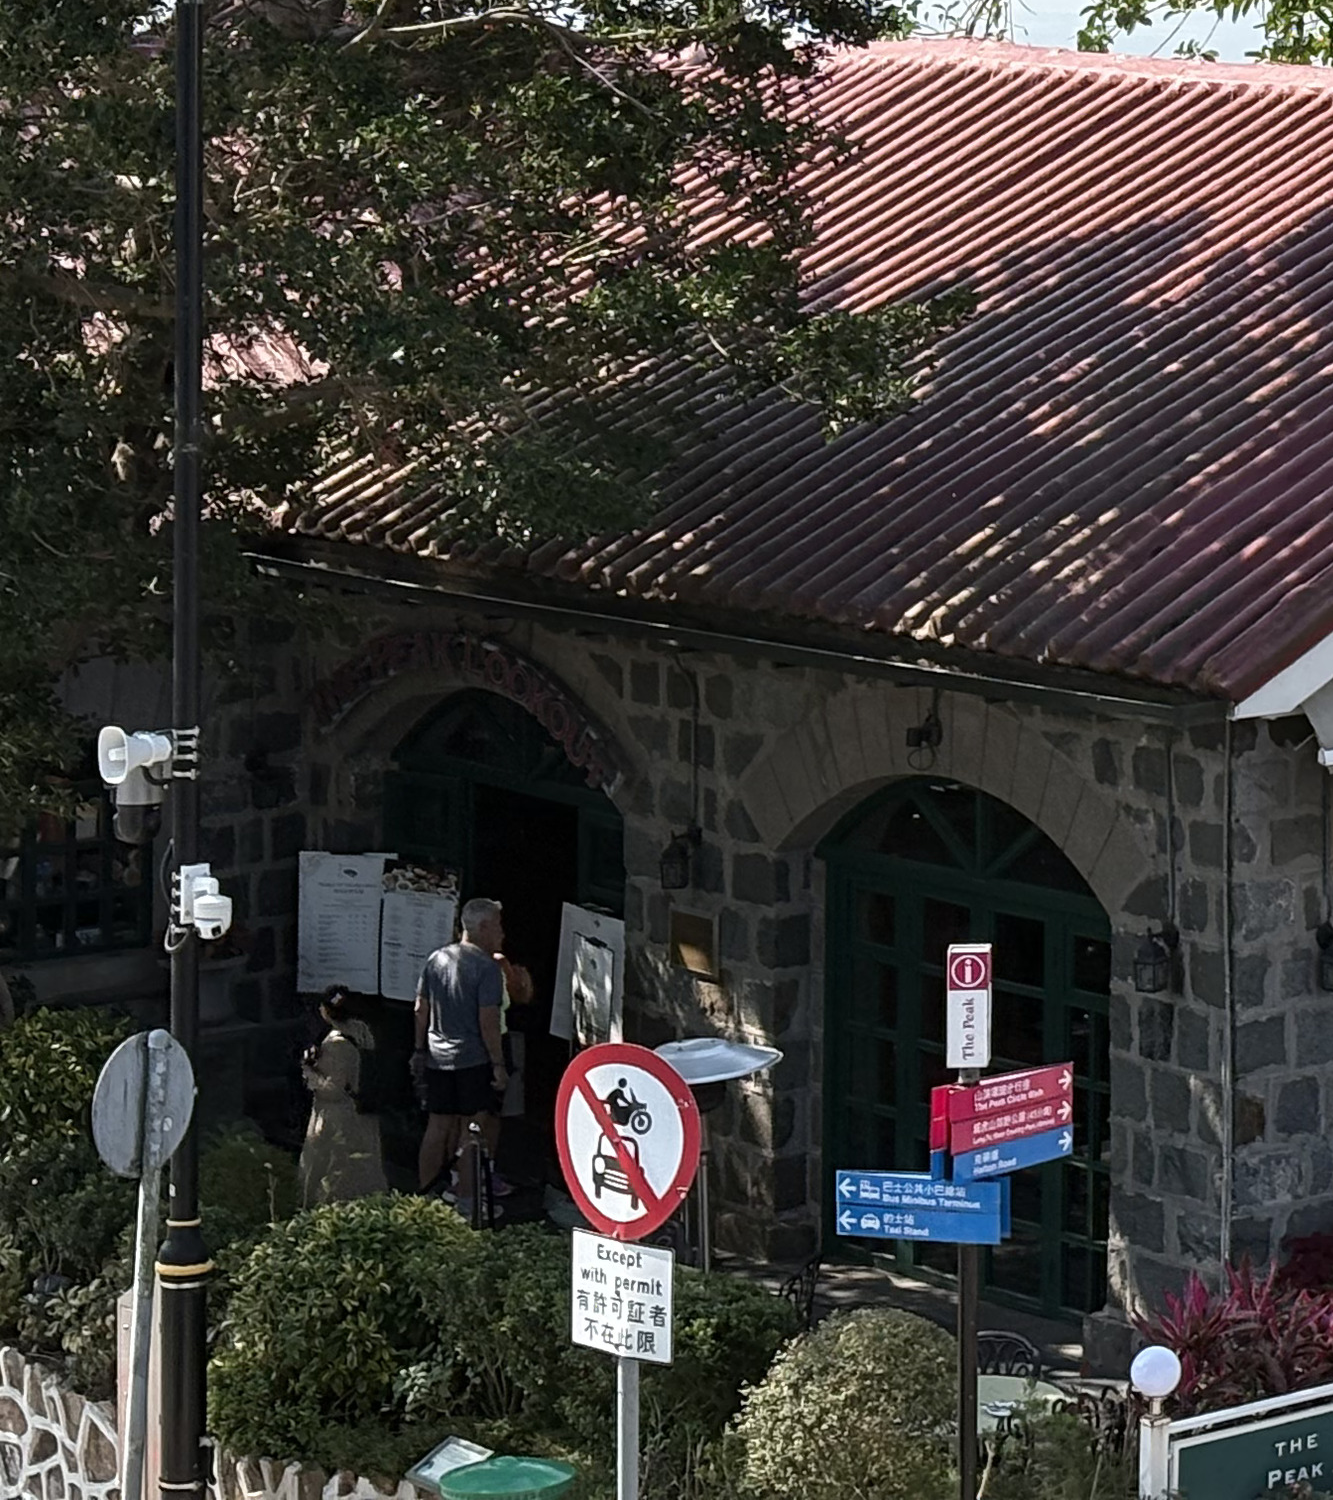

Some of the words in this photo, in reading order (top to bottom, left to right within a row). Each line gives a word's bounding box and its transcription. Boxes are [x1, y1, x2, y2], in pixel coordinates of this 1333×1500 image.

[961, 997, 975, 1029] Peak
[961, 1033, 975, 1061] The
[882, 1193, 900, 1203] Bus
[901, 1194, 937, 1207] Minibus
[903, 1225, 930, 1237] Stand
[596, 1243, 643, 1270] Except
[580, 1266, 607, 1285] with
[614, 1275, 664, 1297] permit
[584, 1317, 657, 1354] 不在此限
[1274, 1432, 1319, 1457] THE
[1267, 1461, 1325, 1489] PEAK
